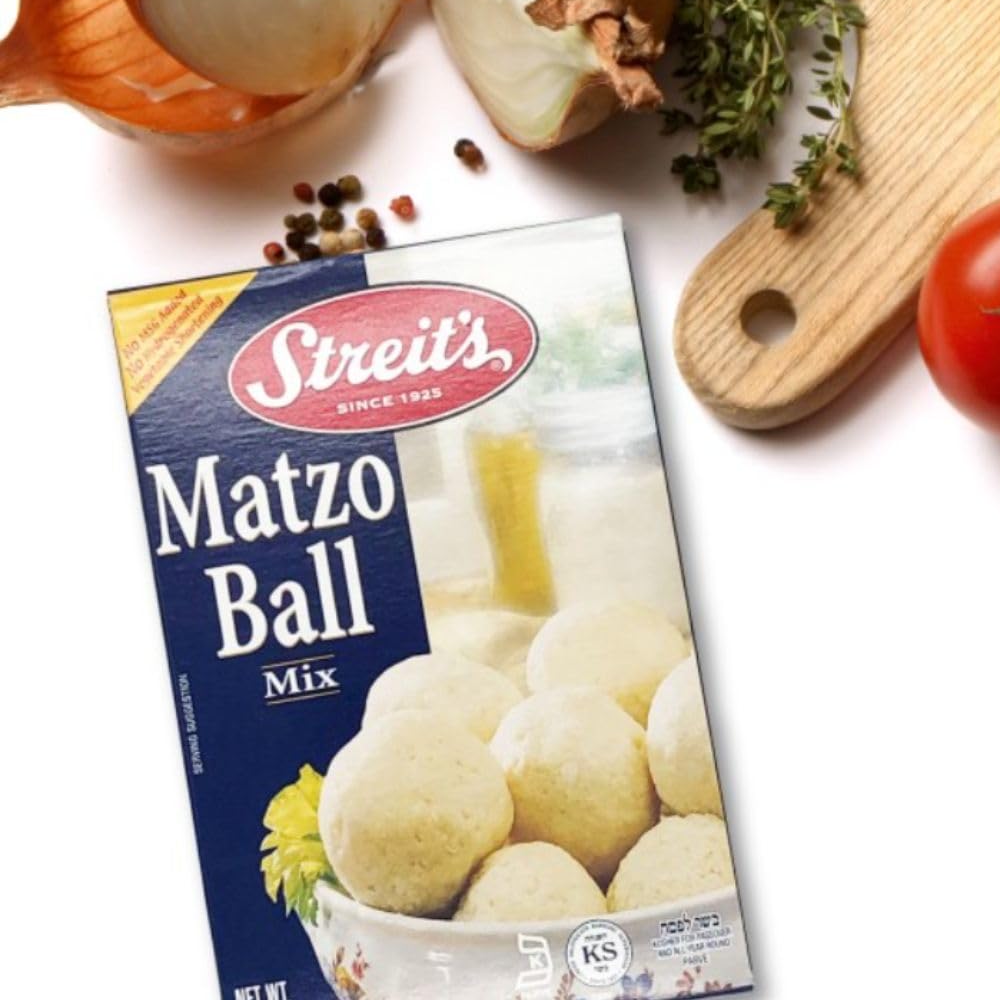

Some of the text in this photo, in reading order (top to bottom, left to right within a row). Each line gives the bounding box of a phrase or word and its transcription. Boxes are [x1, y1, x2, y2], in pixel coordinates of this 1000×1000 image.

[245, 309, 513, 408] Streit's
[336, 387, 442, 415] SINCE 1925
[145, 452, 395, 556] Matzo
[204, 535, 375, 659] Ball
[262, 664, 340, 699] Mix
[582, 941, 618, 964] KS
